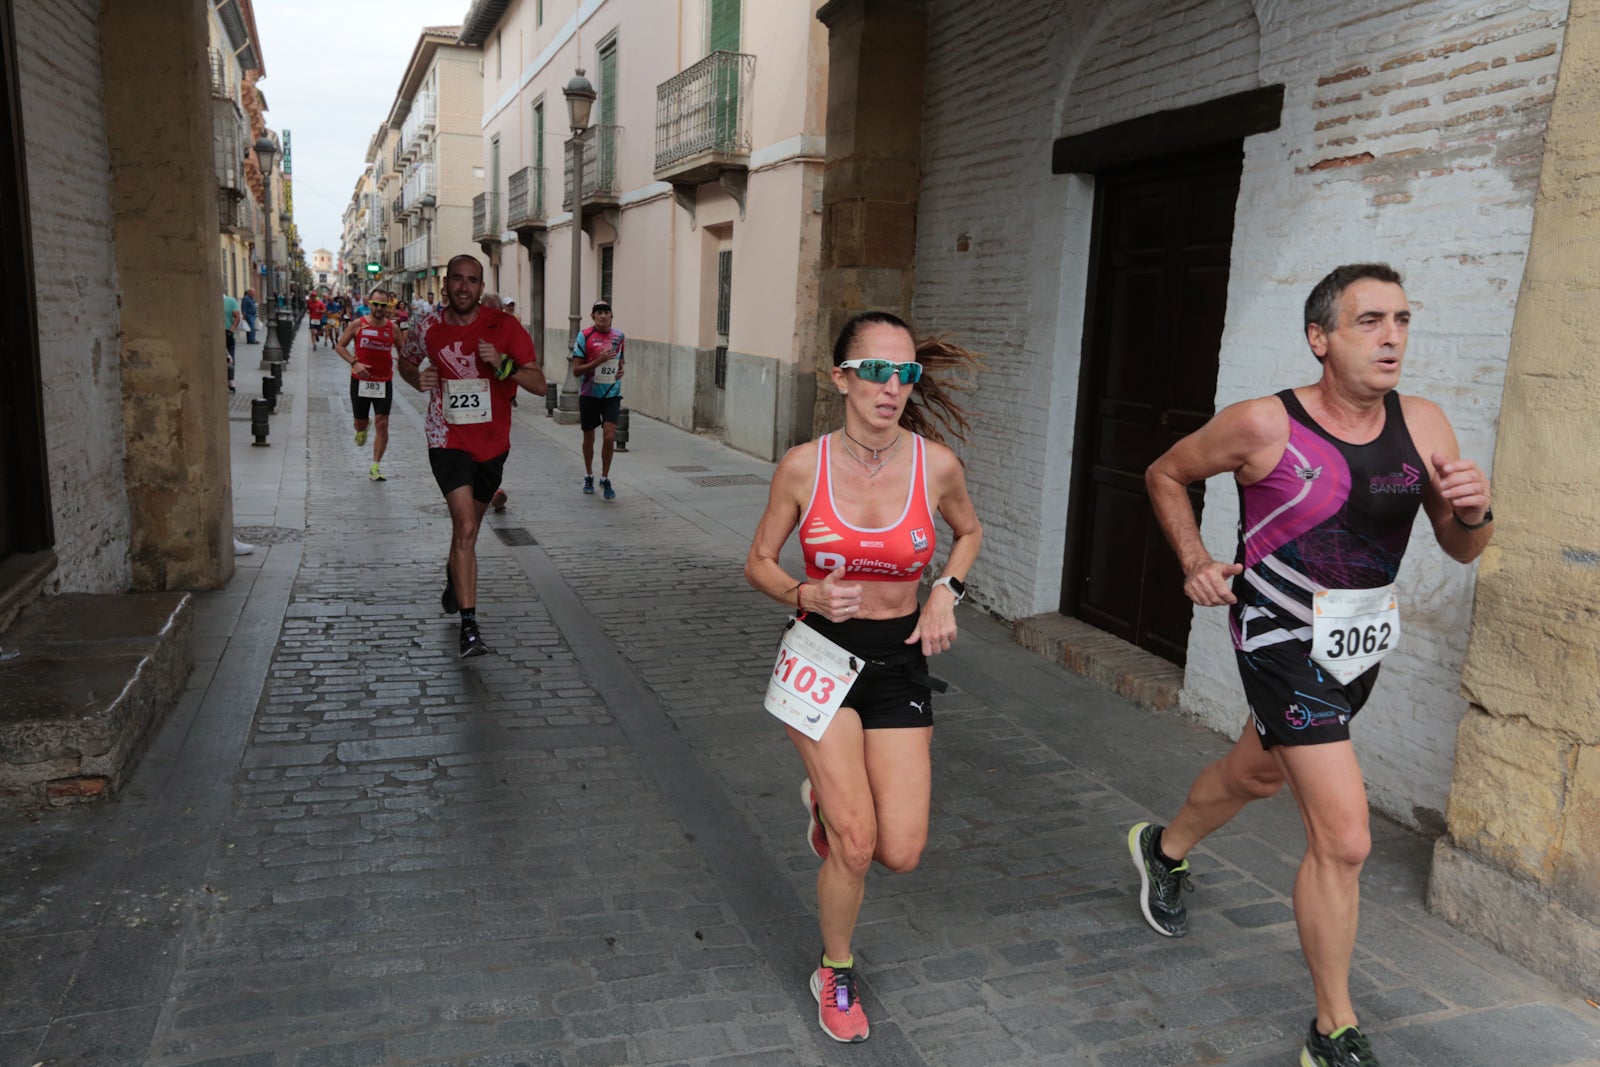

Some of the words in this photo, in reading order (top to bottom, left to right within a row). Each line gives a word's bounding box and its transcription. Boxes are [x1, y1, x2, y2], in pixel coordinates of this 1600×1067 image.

[601, 367, 615, 375] 824
[365, 382, 380, 390] 383
[449, 394, 480, 409] 223
[1369, 484, 1408, 494] SANTA
[1410, 484, 1422, 494] FE
[852, 558, 897, 570] Clínicas
[1326, 622, 1391, 658] 3062
[774, 648, 835, 705] 2103
